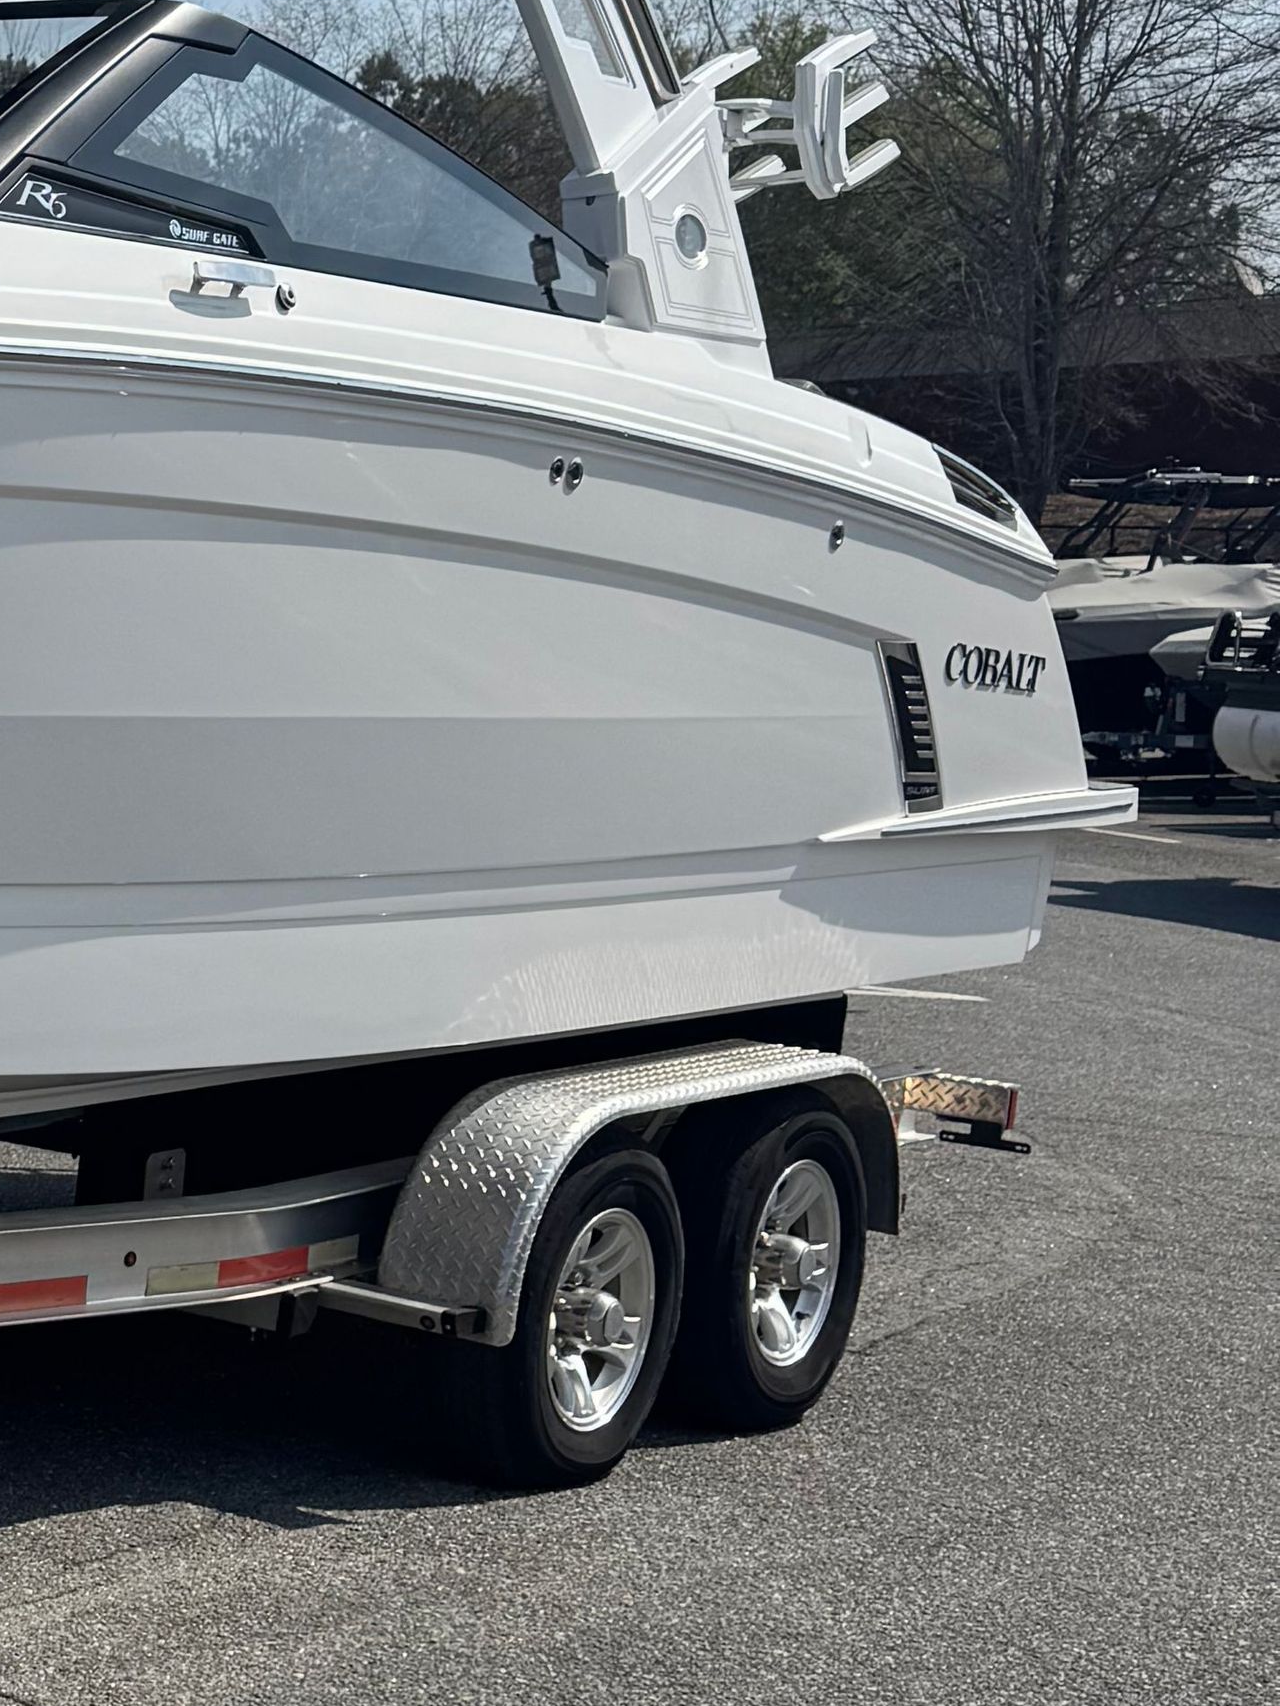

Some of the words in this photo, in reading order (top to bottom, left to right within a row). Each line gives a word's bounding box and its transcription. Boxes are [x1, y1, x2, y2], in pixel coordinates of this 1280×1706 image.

[15, 179, 68, 219] R6
[181, 227, 210, 243] SURF
[212, 232, 240, 248] GATE
[944, 642, 1046, 694] COBALT
